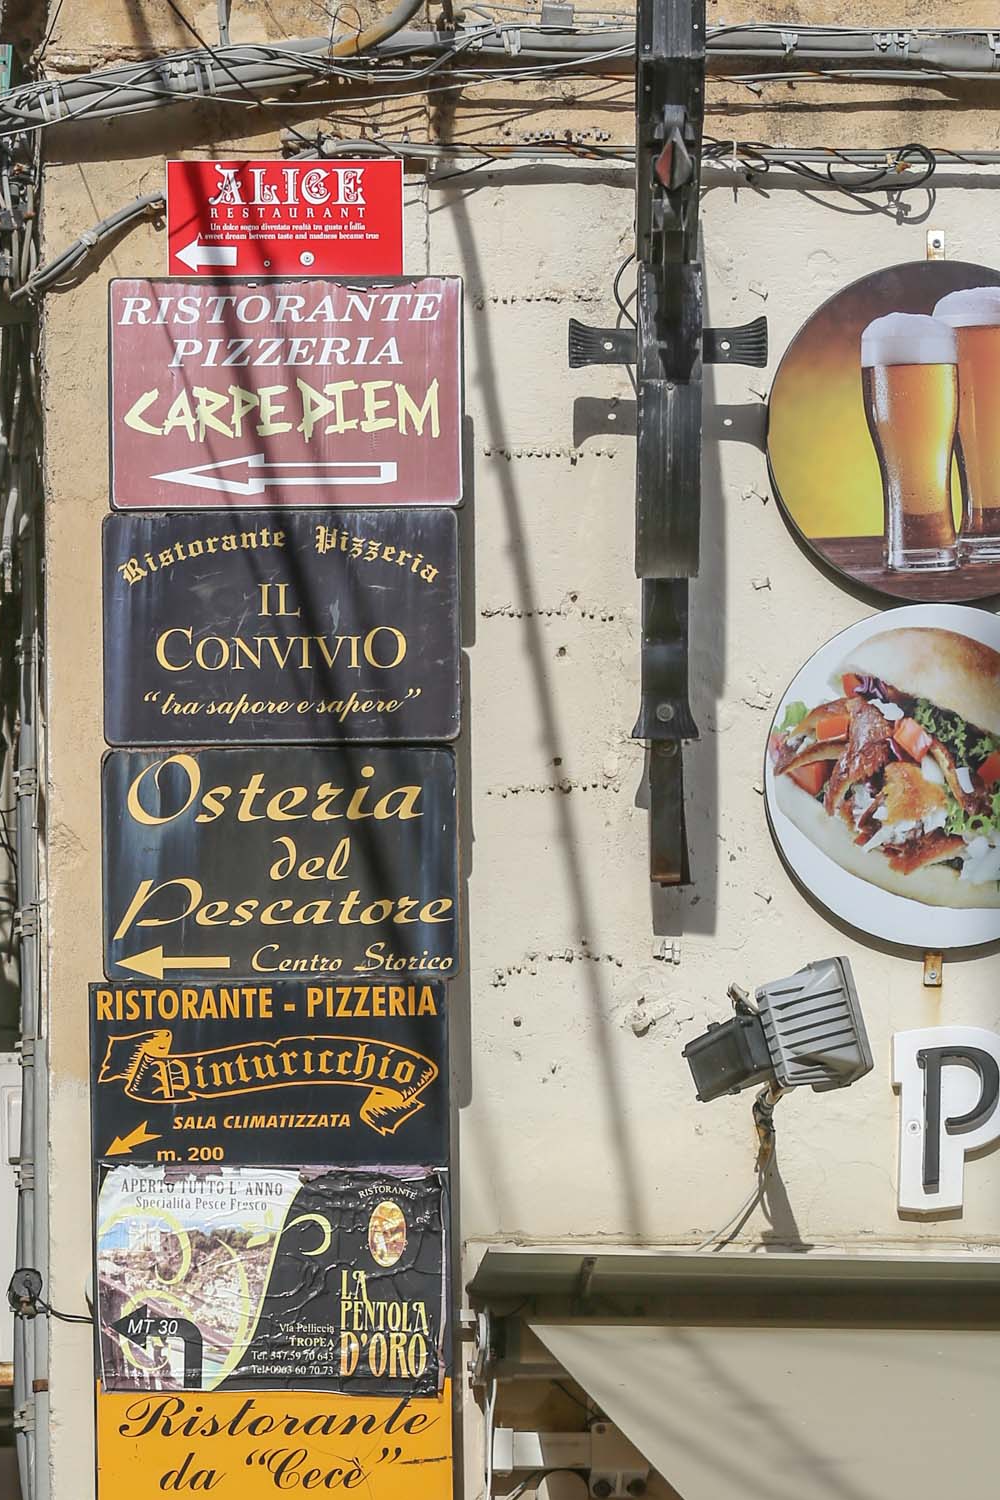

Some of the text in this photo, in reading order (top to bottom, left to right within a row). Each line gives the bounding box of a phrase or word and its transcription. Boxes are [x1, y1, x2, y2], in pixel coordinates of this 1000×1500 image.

[208, 164, 366, 206] ALICE
[210, 207, 366, 219] RESTAURANT
[210, 223, 221, 231] Un
[222, 222, 239, 231] dolce
[205, 232, 224, 240] sweet
[225, 231, 247, 240] dream
[248, 231, 276, 240] between
[277, 232, 294, 240] taste
[294, 231, 307, 240] and
[339, 231, 364, 240] became
[117, 293, 442, 325] RISTORANTE
[167, 336, 403, 368] PIZZERIA
[117, 523, 440, 587] Ristorante Pizzeria
[257, 582, 301, 617] IL
[155, 625, 408, 672] CONVIVIO
[206, 693, 295, 724] sapore
[297, 699, 315, 714] e
[127, 753, 425, 826] Osteria
[269, 835, 351, 881] del
[113, 877, 455, 941] Pescatore
[251, 940, 454, 973] Centro Storico
[97, 987, 273, 1021] RISTORANTE
[307, 985, 438, 1019] PIZZERIA
[151, 1043, 418, 1099] Pinturicchio
[172, 1113, 351, 1130] SALA CLIMATIZZATA
[914, 1042, 1000, 1196] P
[156, 1146, 224, 1162] m. 200
[180, 1179, 224, 1195] TUTTO
[245, 1181, 283, 1197] ANNO
[195, 1197, 226, 1210] Pesce
[358, 1184, 418, 1200] RISTORANTE
[341, 1269, 368, 1301] LA
[127, 1319, 179, 1335] MT 30
[279, 1323, 294, 1333] Via
[340, 1301, 429, 1335] PENTOLA
[289, 1337, 334, 1347] TROPEA
[340, 1332, 428, 1378] D'ORO
[294, 1365, 307, 1375] 60
[118, 1394, 441, 1438] Ristorante
[159, 1452, 227, 1491] da
